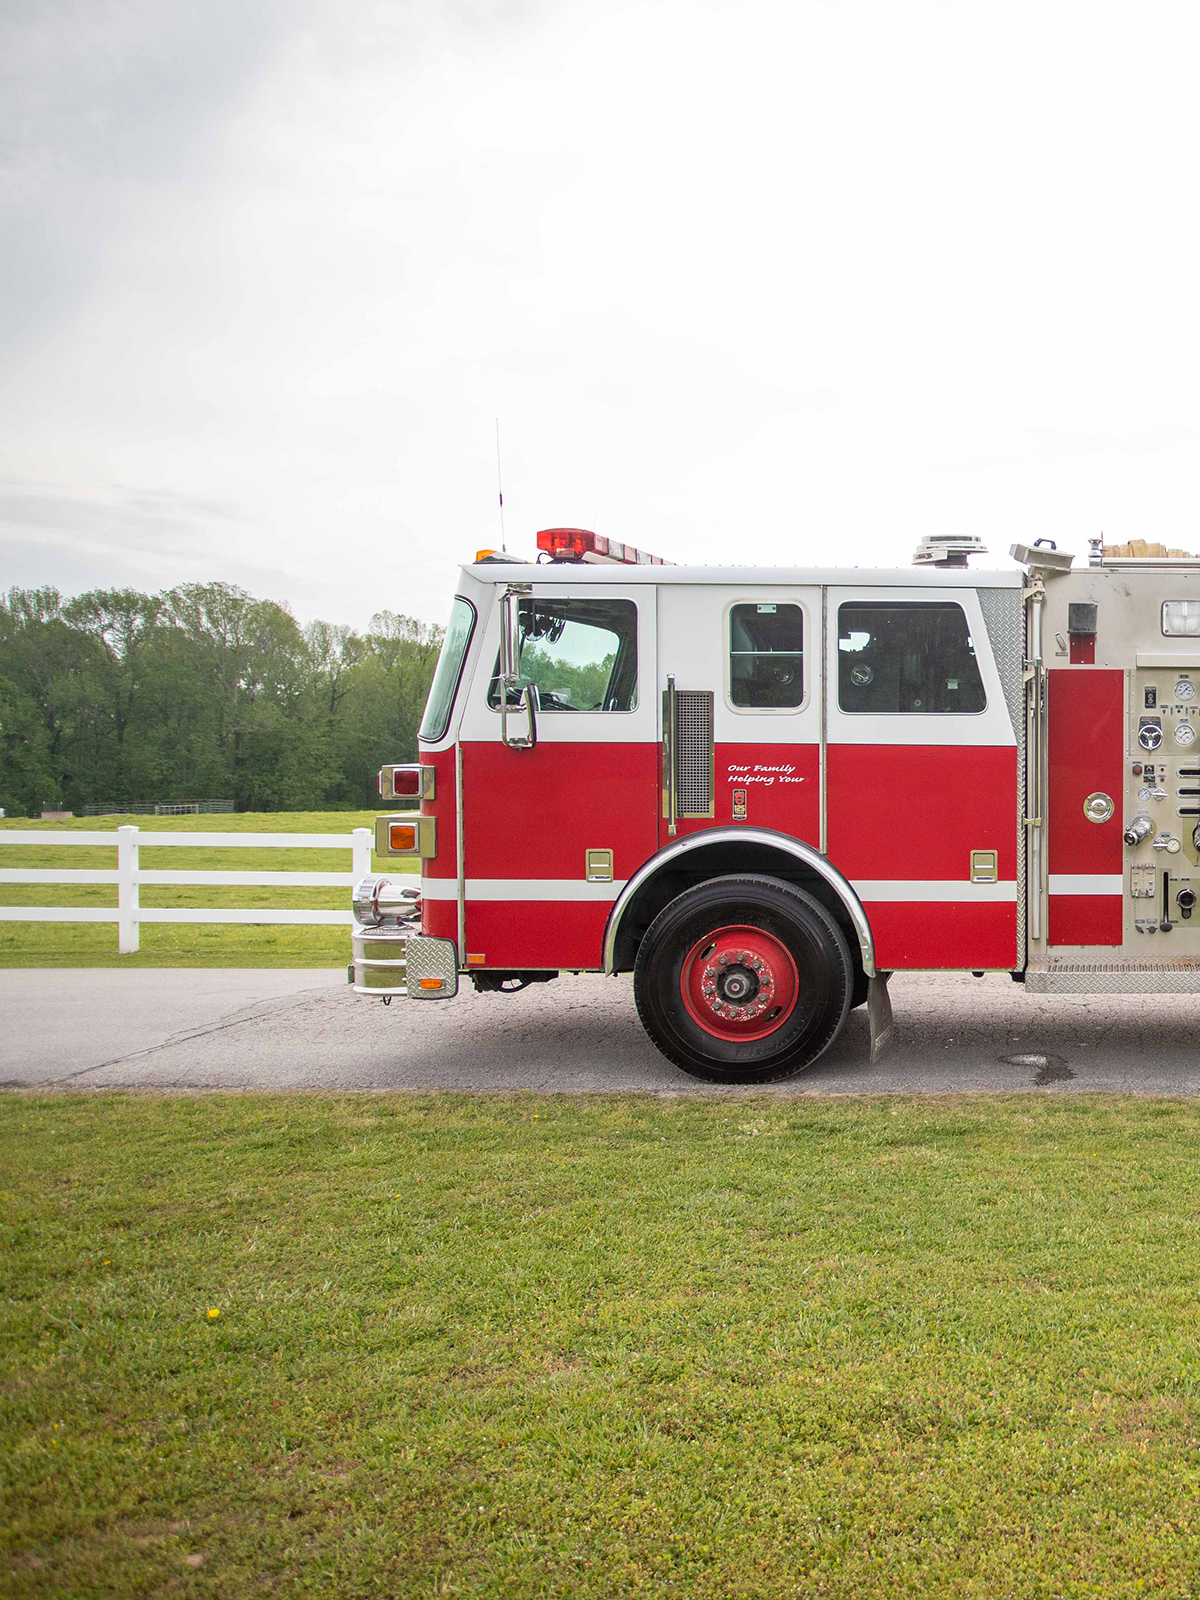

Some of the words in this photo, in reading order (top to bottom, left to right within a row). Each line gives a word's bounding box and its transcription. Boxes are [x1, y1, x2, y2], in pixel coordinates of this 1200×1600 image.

[727, 764, 751, 772] Our
[753, 764, 796, 775] Family
[727, 774, 775, 786] Helping
[778, 775, 805, 783] Your
